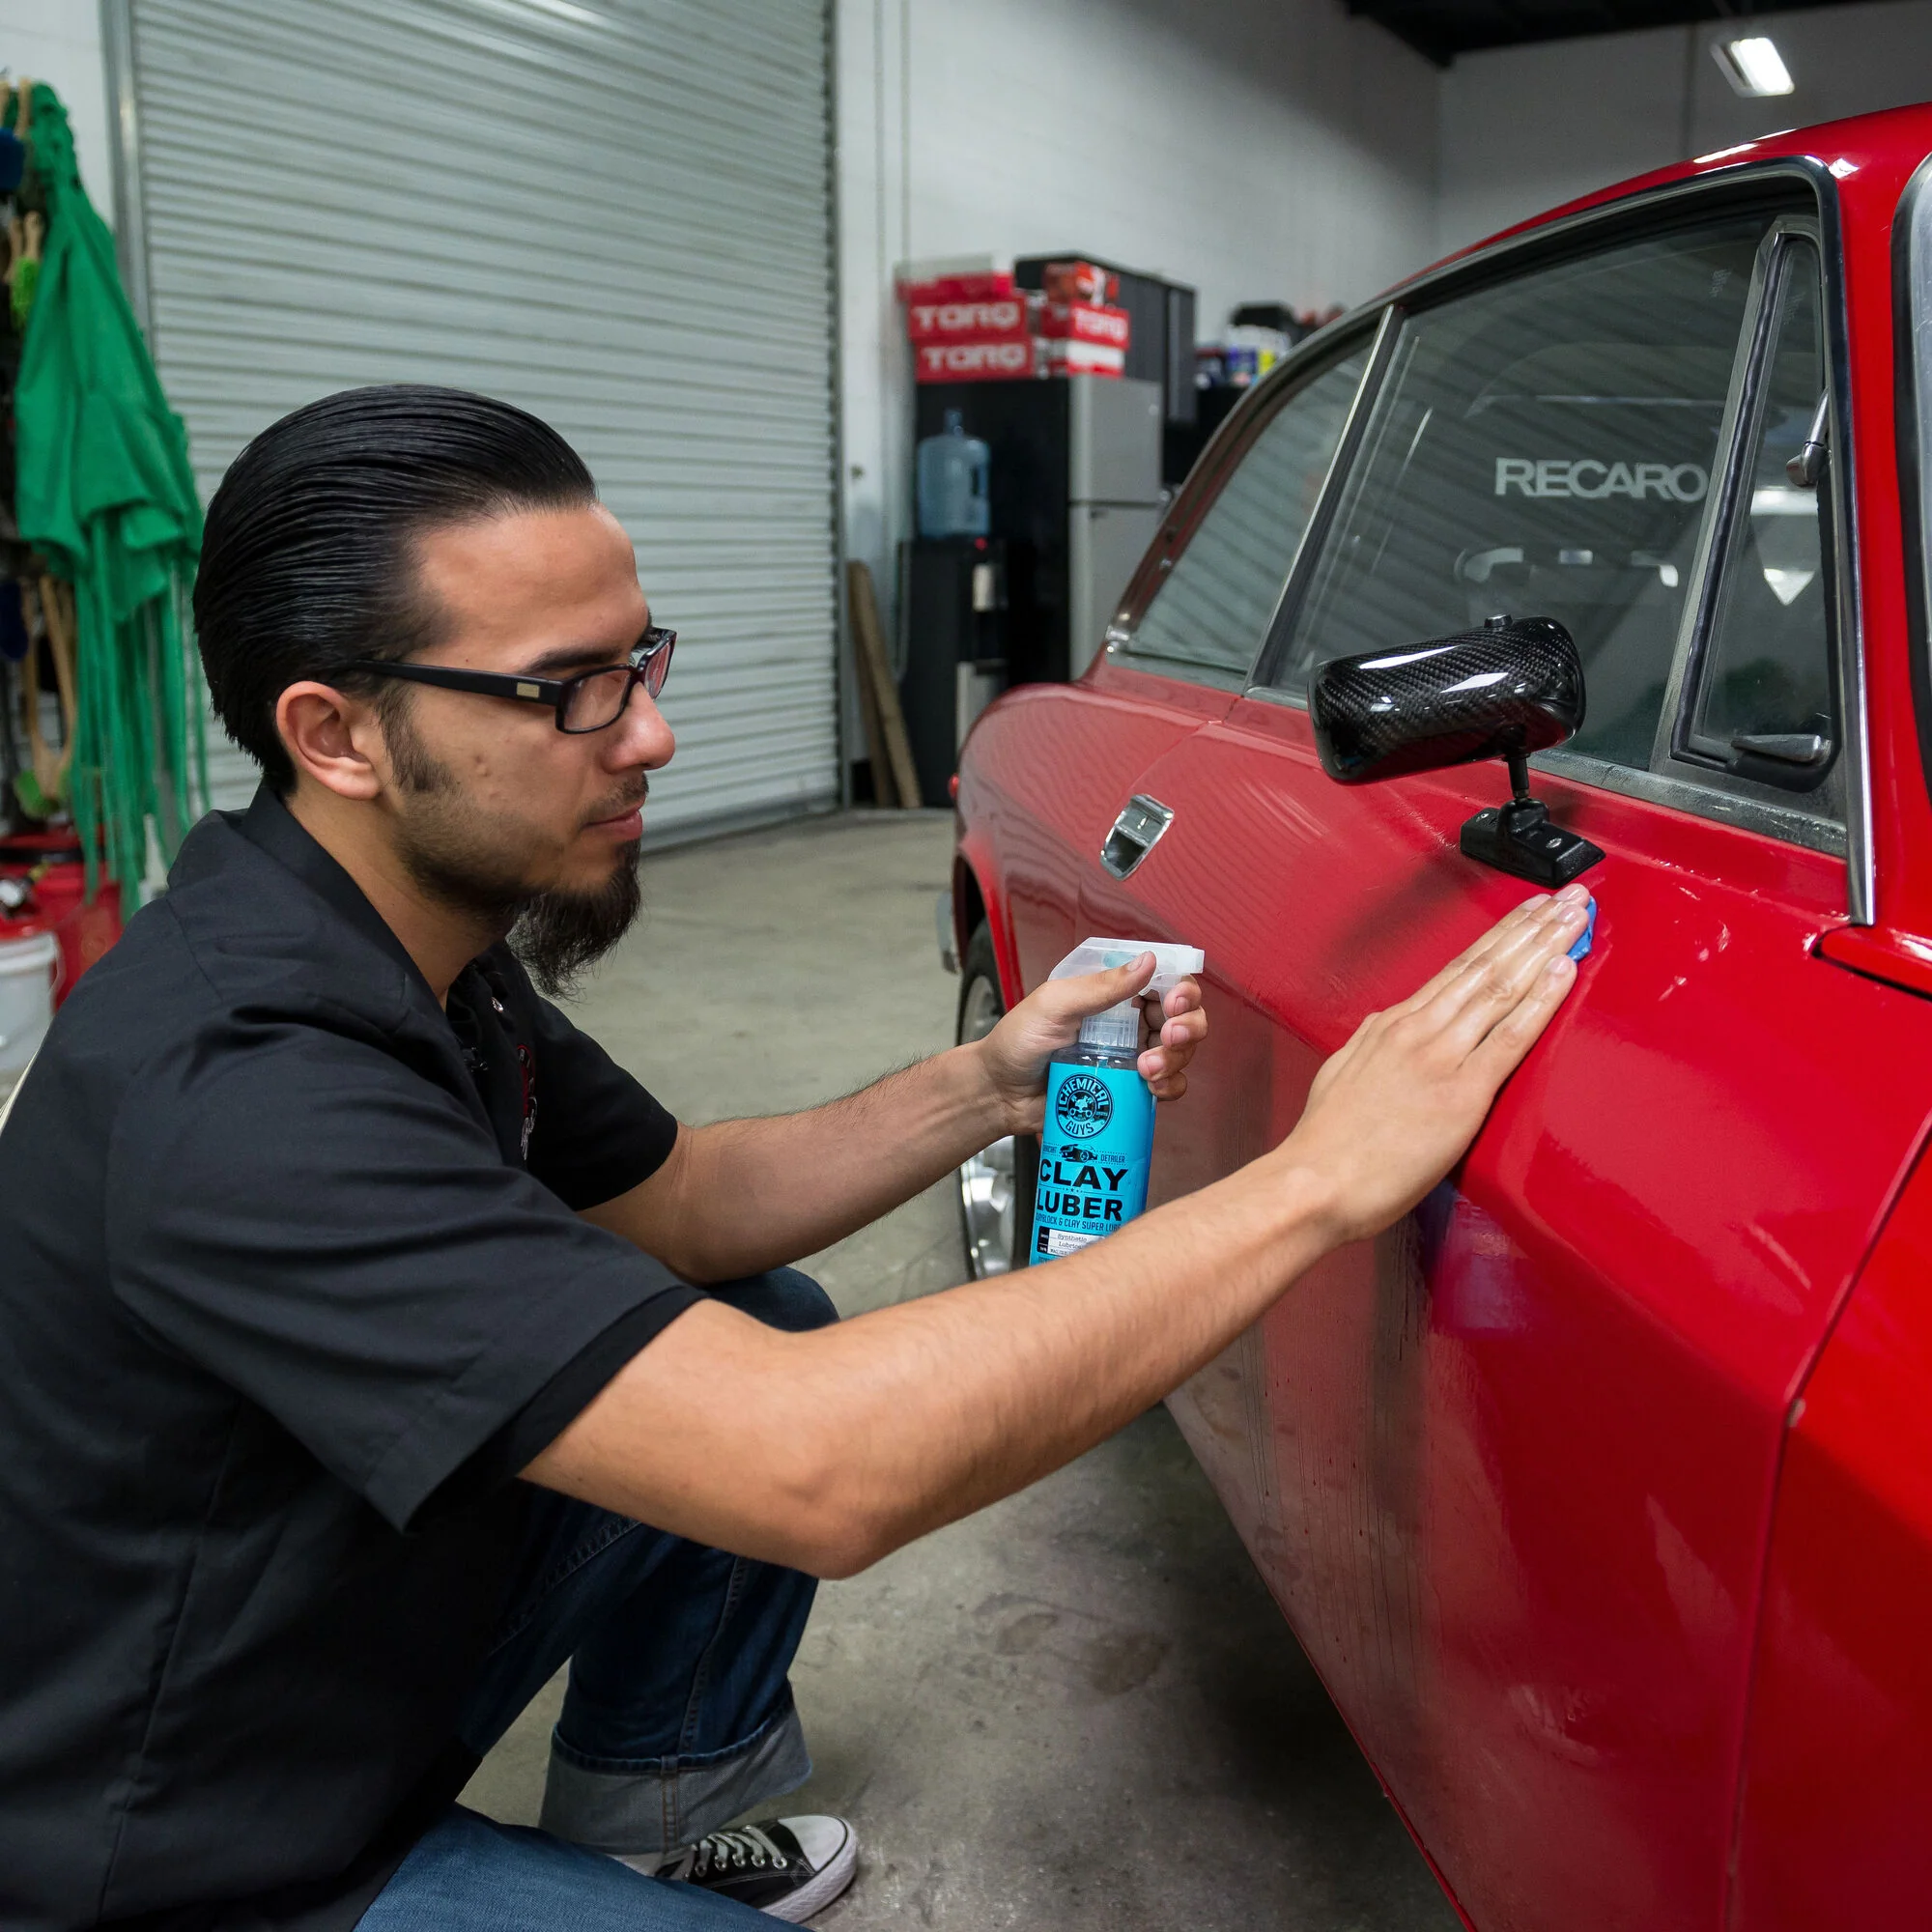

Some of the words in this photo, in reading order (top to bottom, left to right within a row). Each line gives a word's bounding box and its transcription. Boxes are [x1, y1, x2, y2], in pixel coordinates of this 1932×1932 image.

[1494, 457, 1709, 503] RECARO
[1059, 1077, 1109, 1110] CHEMICAL
[1065, 1121, 1094, 1135] GUYS
[1039, 1158, 1128, 1192] CLAY
[1037, 1188, 1122, 1222] LUBER
[1064, 1219, 1081, 1229] CLAY
[1082, 1221, 1103, 1232] SUPER
